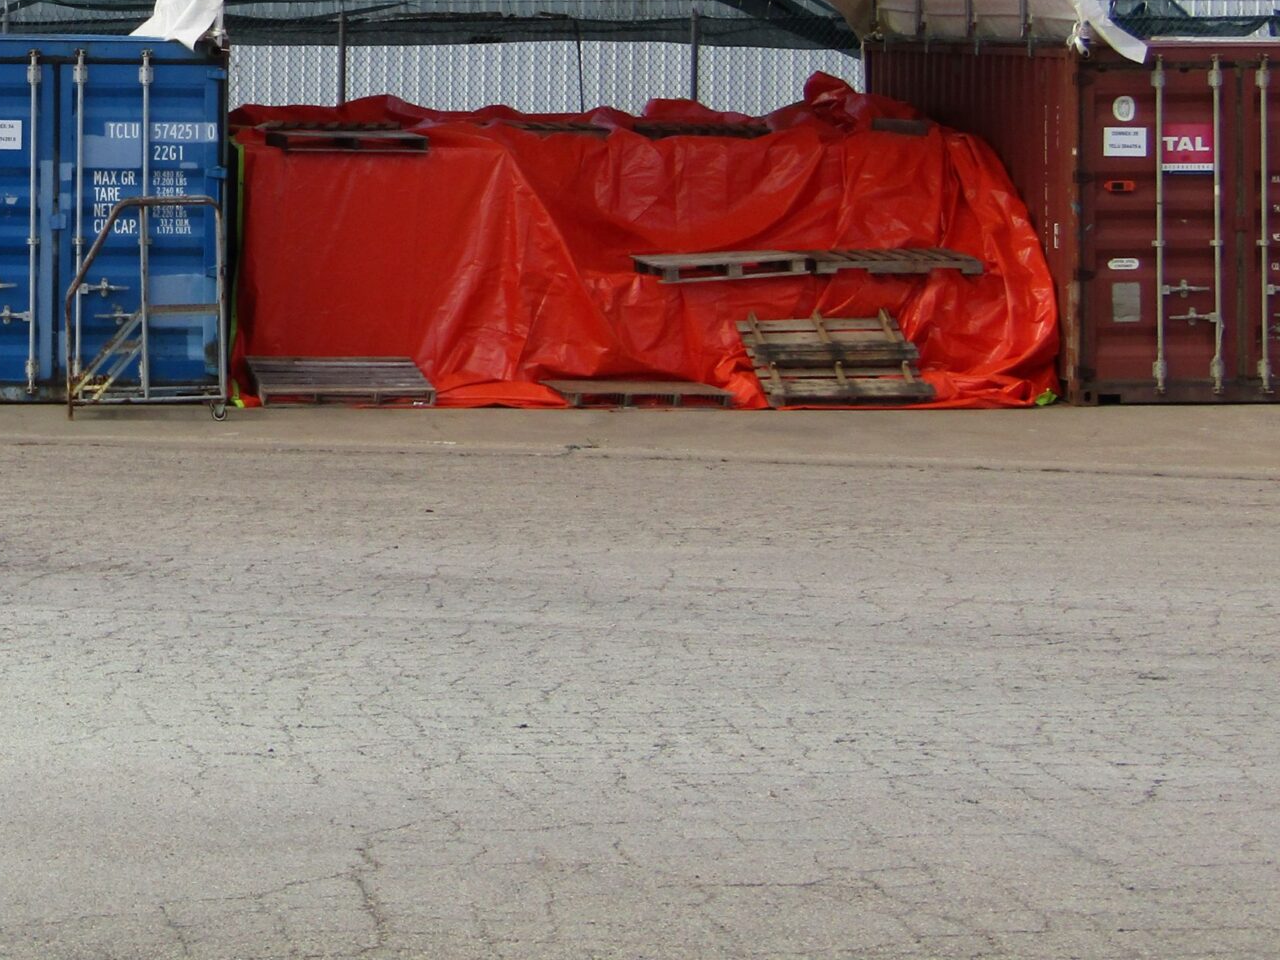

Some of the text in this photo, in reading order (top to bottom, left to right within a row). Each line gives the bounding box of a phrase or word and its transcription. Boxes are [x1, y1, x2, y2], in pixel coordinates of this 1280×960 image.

[109, 123, 139, 139] TCLU
[154, 124, 199, 140] 574251
[1162, 136, 1210, 151] TAL
[154, 145, 183, 160] 22G1
[176, 177, 187, 186] LBS
[94, 187, 121, 201] TARE
[94, 203, 114, 218] NET
